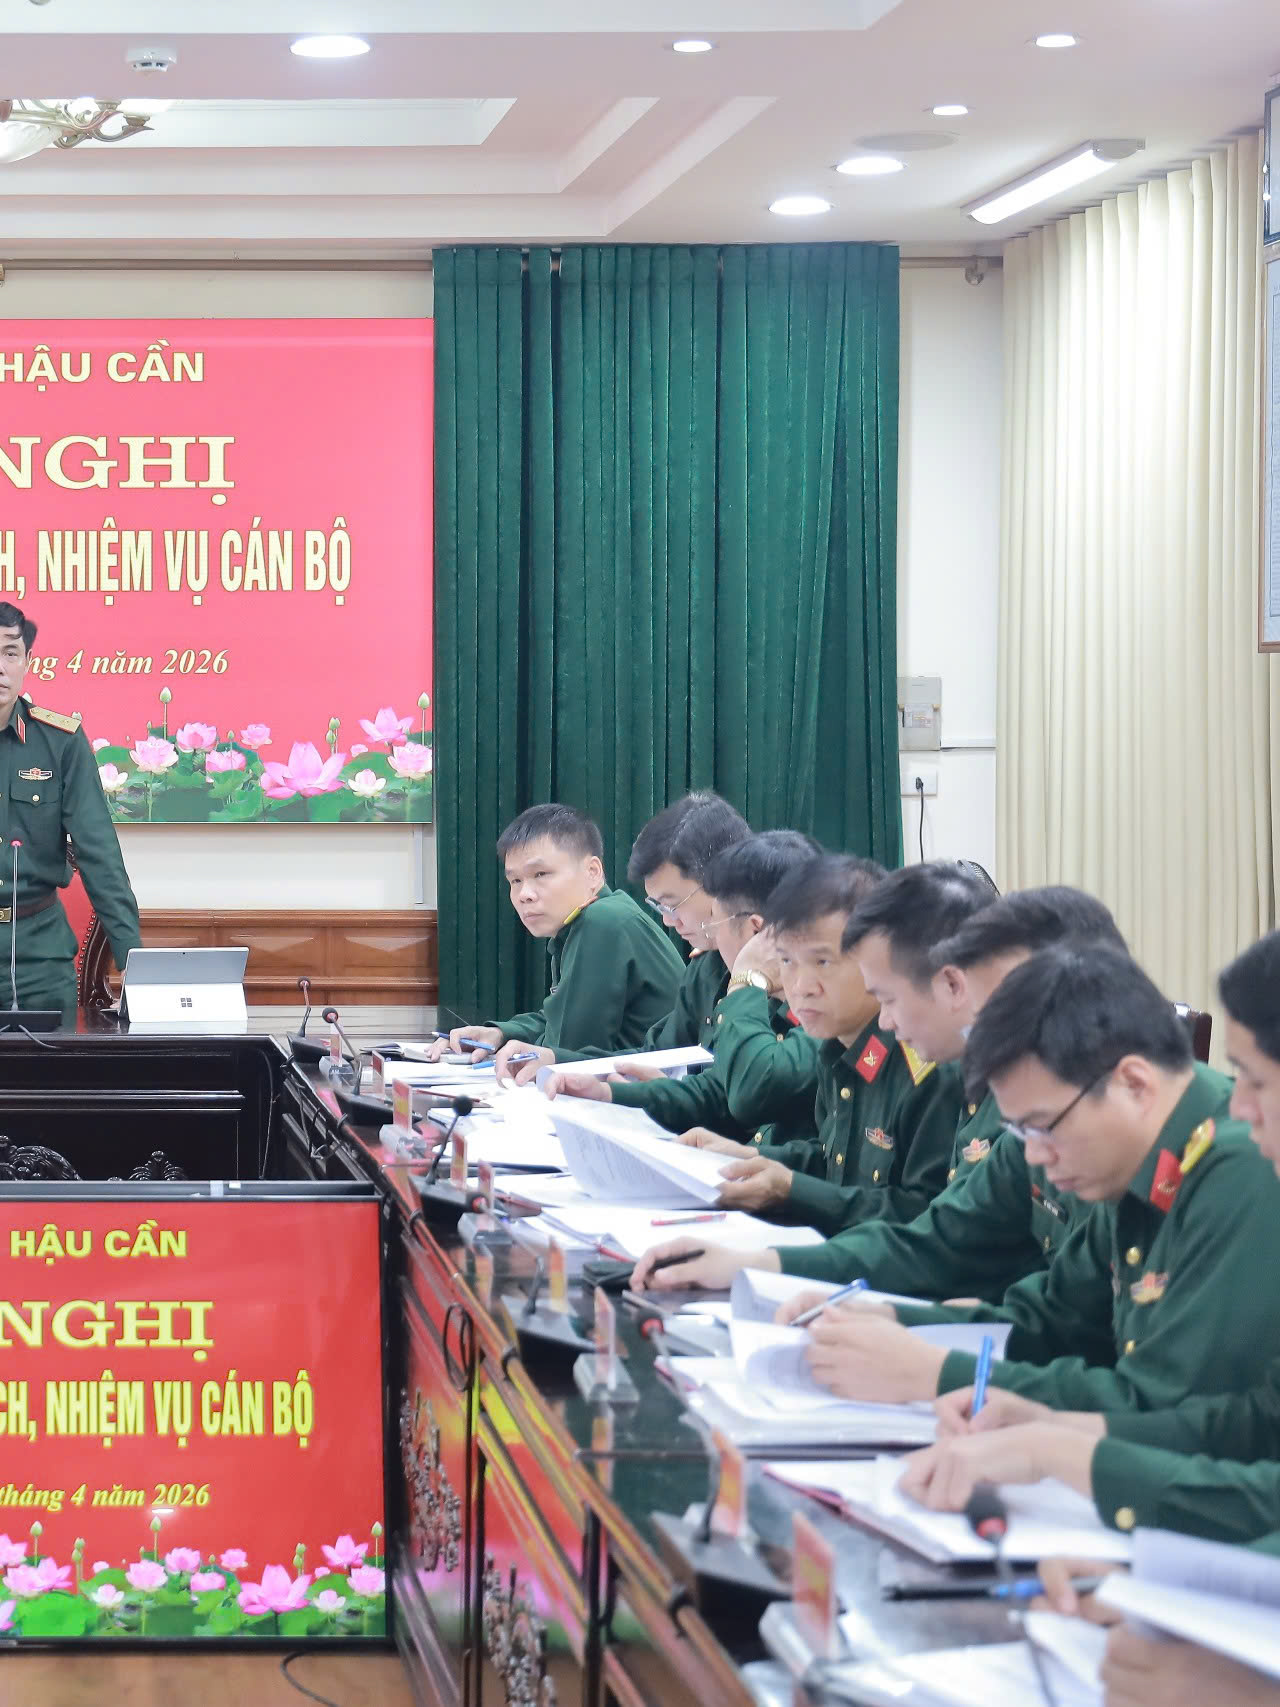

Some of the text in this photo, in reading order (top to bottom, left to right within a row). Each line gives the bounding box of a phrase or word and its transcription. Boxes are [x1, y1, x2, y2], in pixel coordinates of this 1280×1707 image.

[107, 339, 204, 383] CẦN
[38, 516, 153, 606] NHIỆM
[163, 529, 209, 606] VỤ
[220, 516, 293, 592] CÁN
[305, 516, 352, 606] BỘ
[66, 649, 84, 674] 4
[91, 649, 153, 674] năm
[161, 649, 229, 674] 2026
[10, 1223, 93, 1266] HẬU
[104, 1219, 188, 1258] CẦN
[45, 1369, 145, 1449] NHIỆM
[152, 1379, 193, 1449] VỤ
[200, 1369, 265, 1437] CÁN
[272, 1369, 315, 1449] BỘ
[70, 1483, 87, 1507] 4
[91, 1483, 146, 1507] năm
[151, 1483, 211, 1508] 2026
